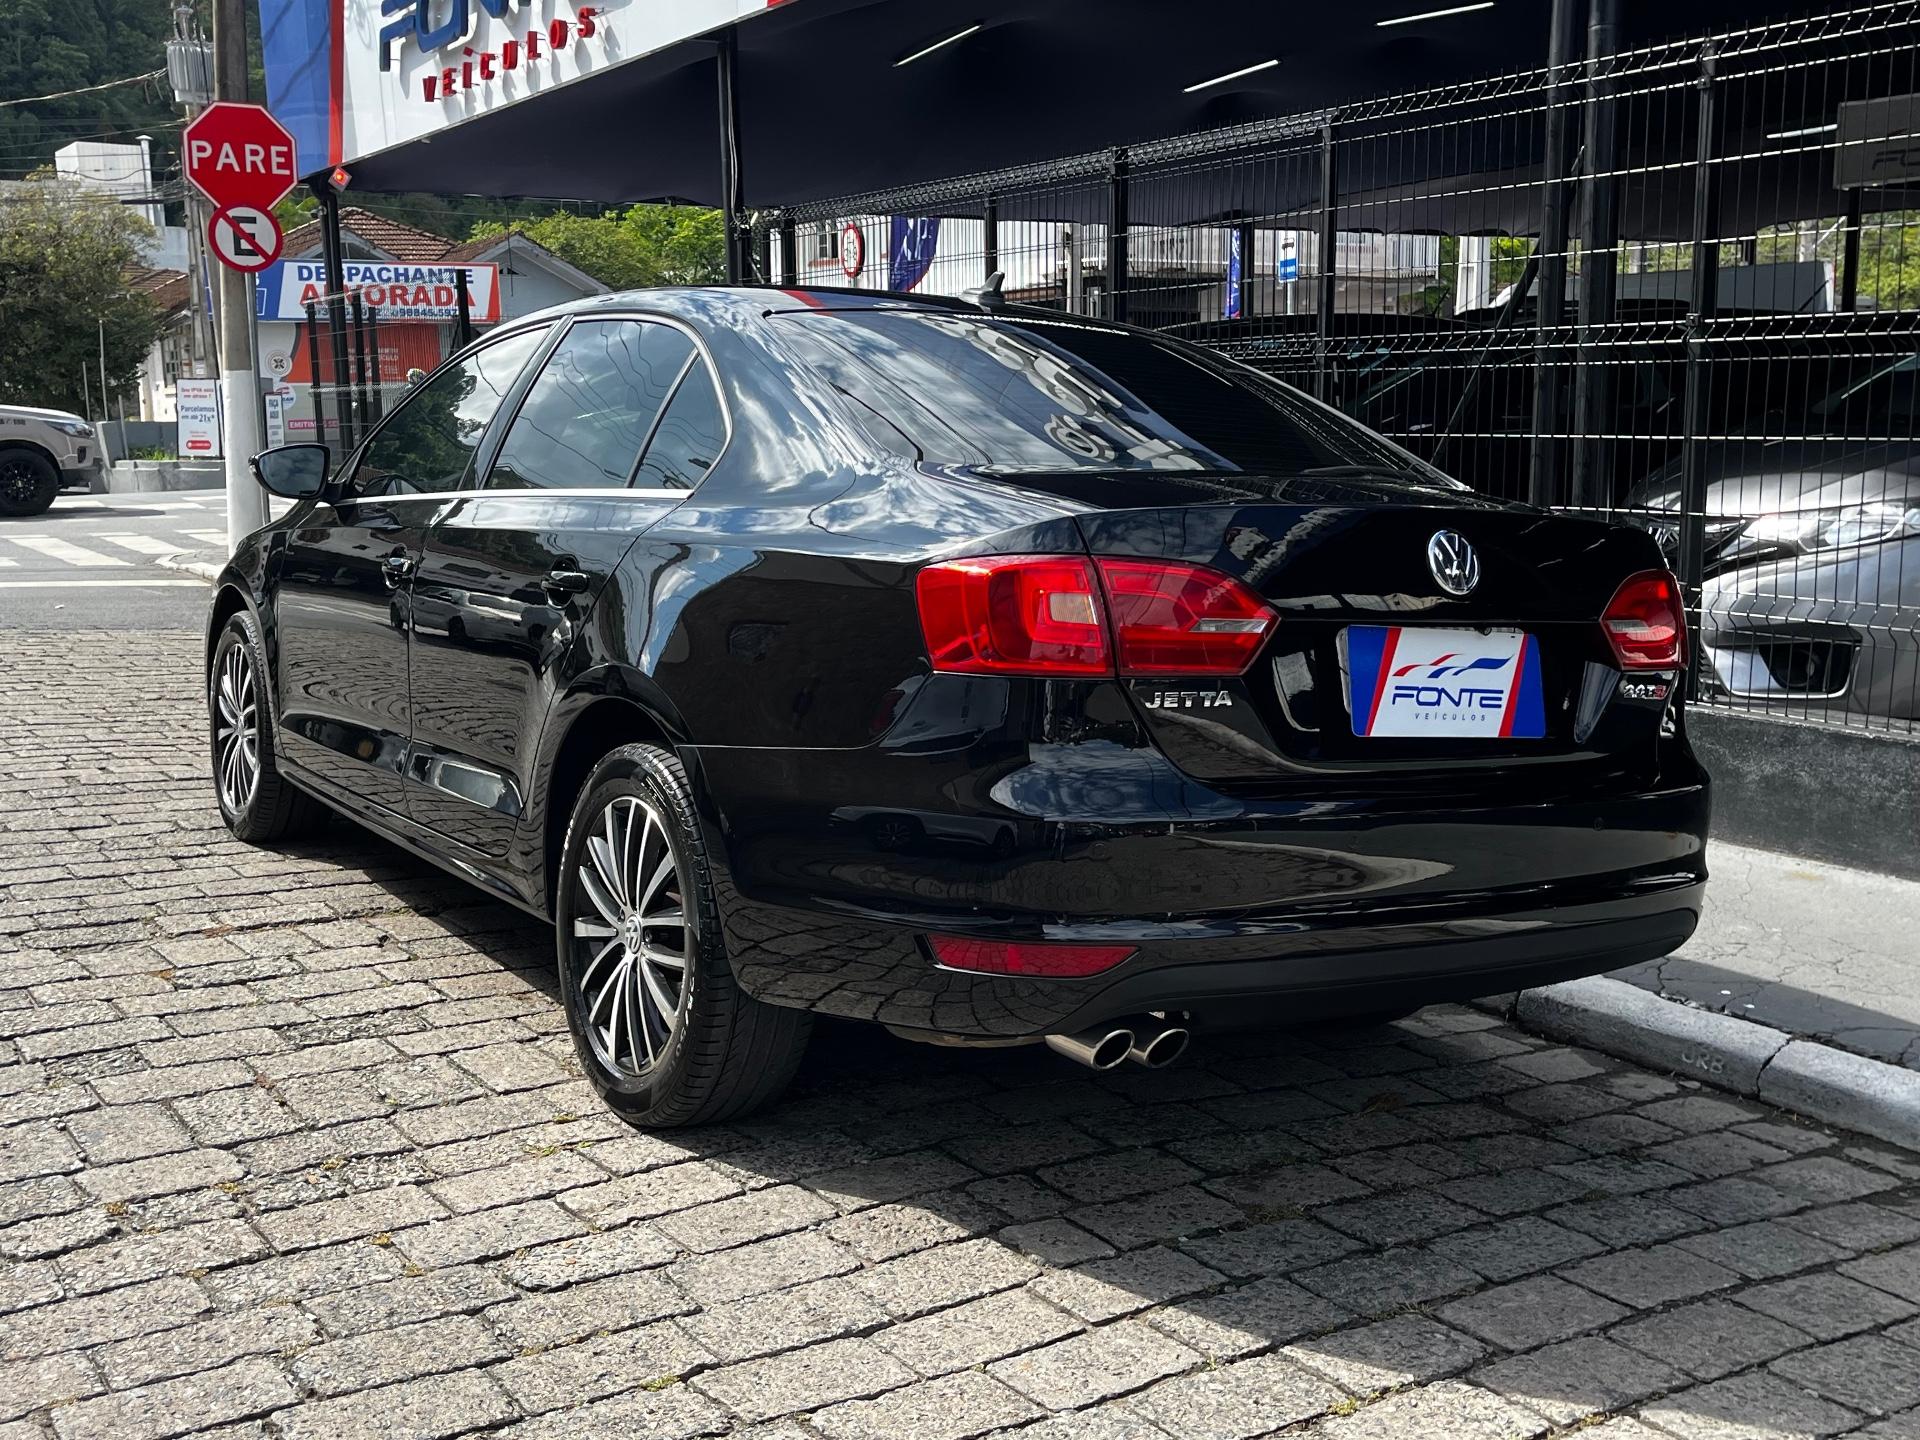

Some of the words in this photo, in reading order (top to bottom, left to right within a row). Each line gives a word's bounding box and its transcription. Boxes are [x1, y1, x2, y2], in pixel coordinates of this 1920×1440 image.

[190, 140, 291, 176] PARE
[231, 215, 259, 256] E
[297, 265, 474, 284] DEPACHANTE
[180, 404, 215, 413] Parcelamos
[1144, 690, 1233, 709] JETTA
[1392, 685, 1504, 709] FONTE
[1414, 711, 1486, 722] VEÍCULOS
